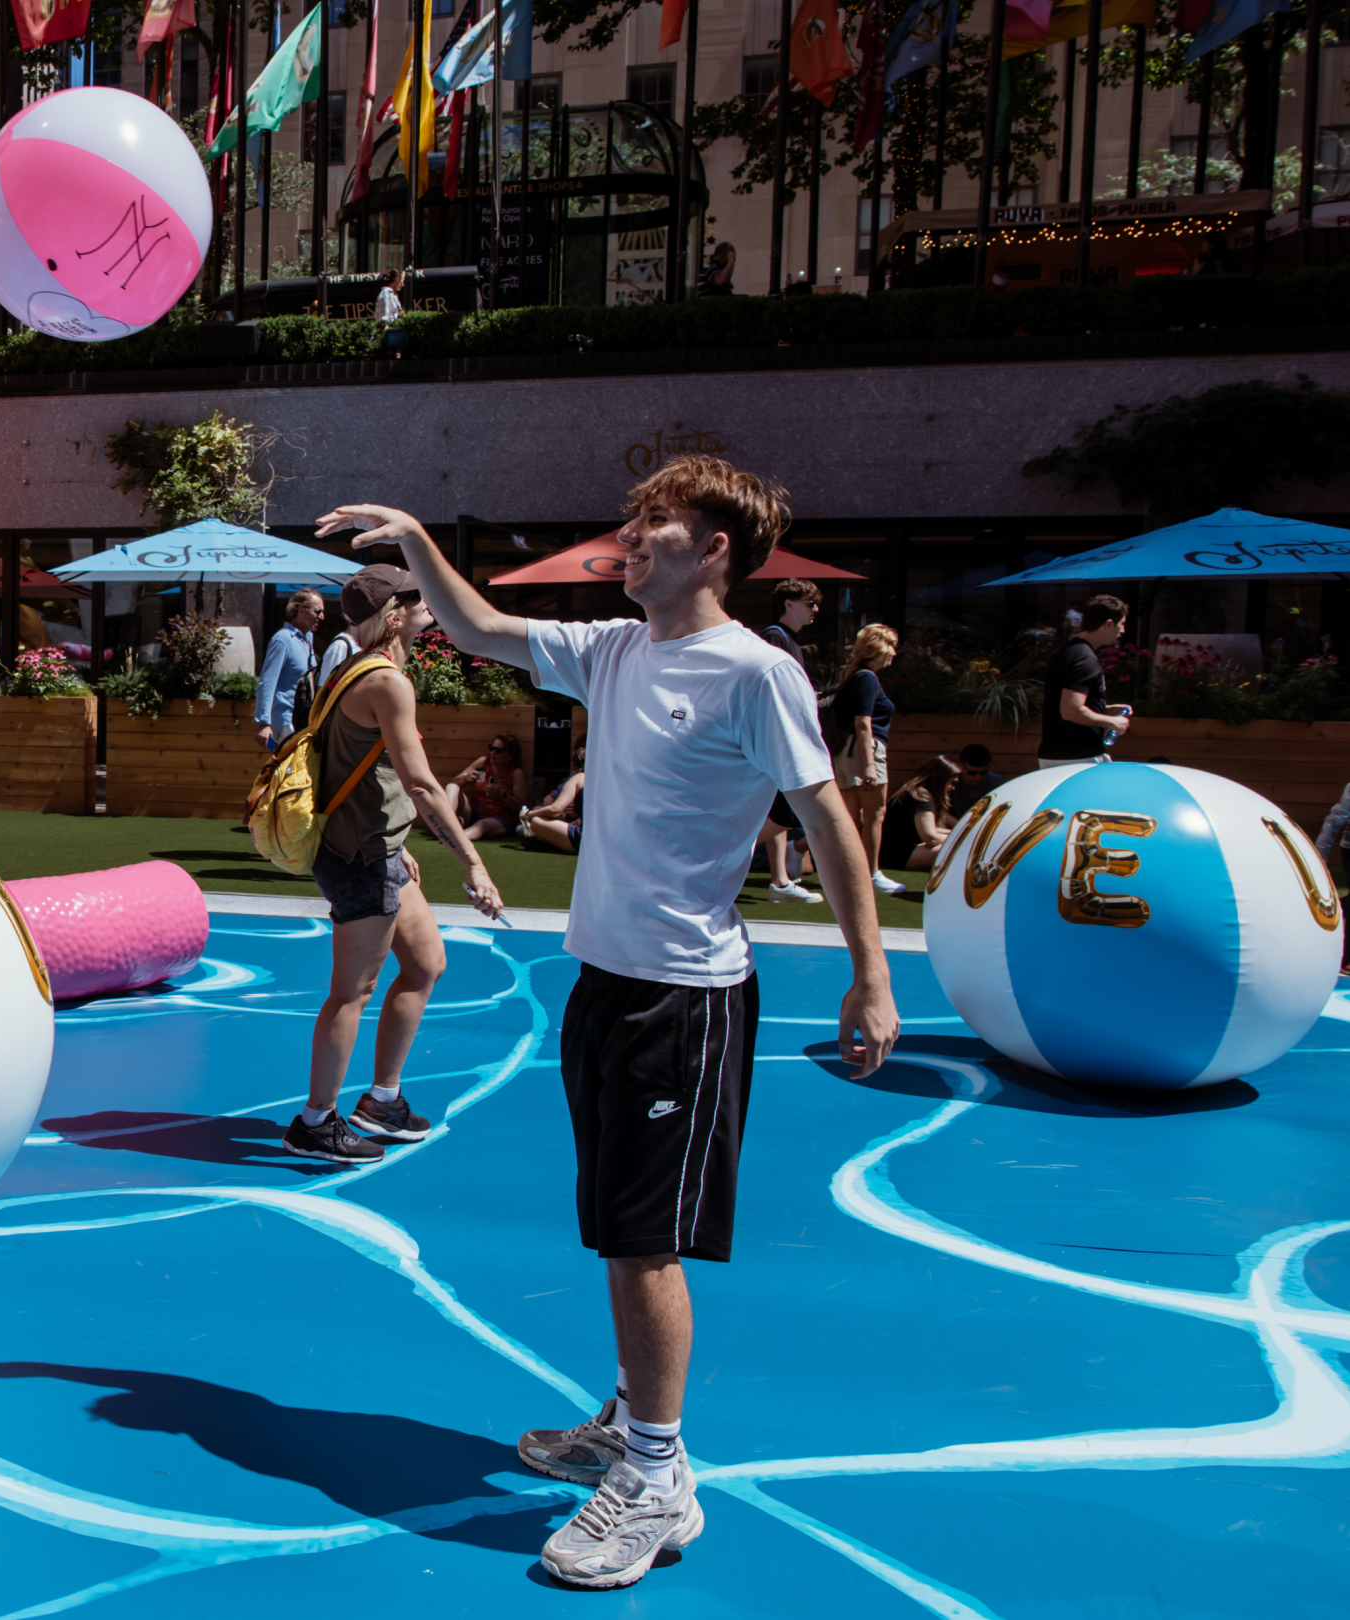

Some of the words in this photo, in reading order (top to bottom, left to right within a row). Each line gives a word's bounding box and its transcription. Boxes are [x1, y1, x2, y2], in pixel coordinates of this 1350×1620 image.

[538, 181, 575, 192] SHOPS
[995, 207, 1044, 223] PUYA
[1118, 201, 1176, 216] PUEBLA
[348, 272, 381, 283] TIPSY
[136, 544, 288, 568] Jupiter
[1184, 538, 1350, 571] Jupite
[653, 1100, 677, 1111] NIKE
